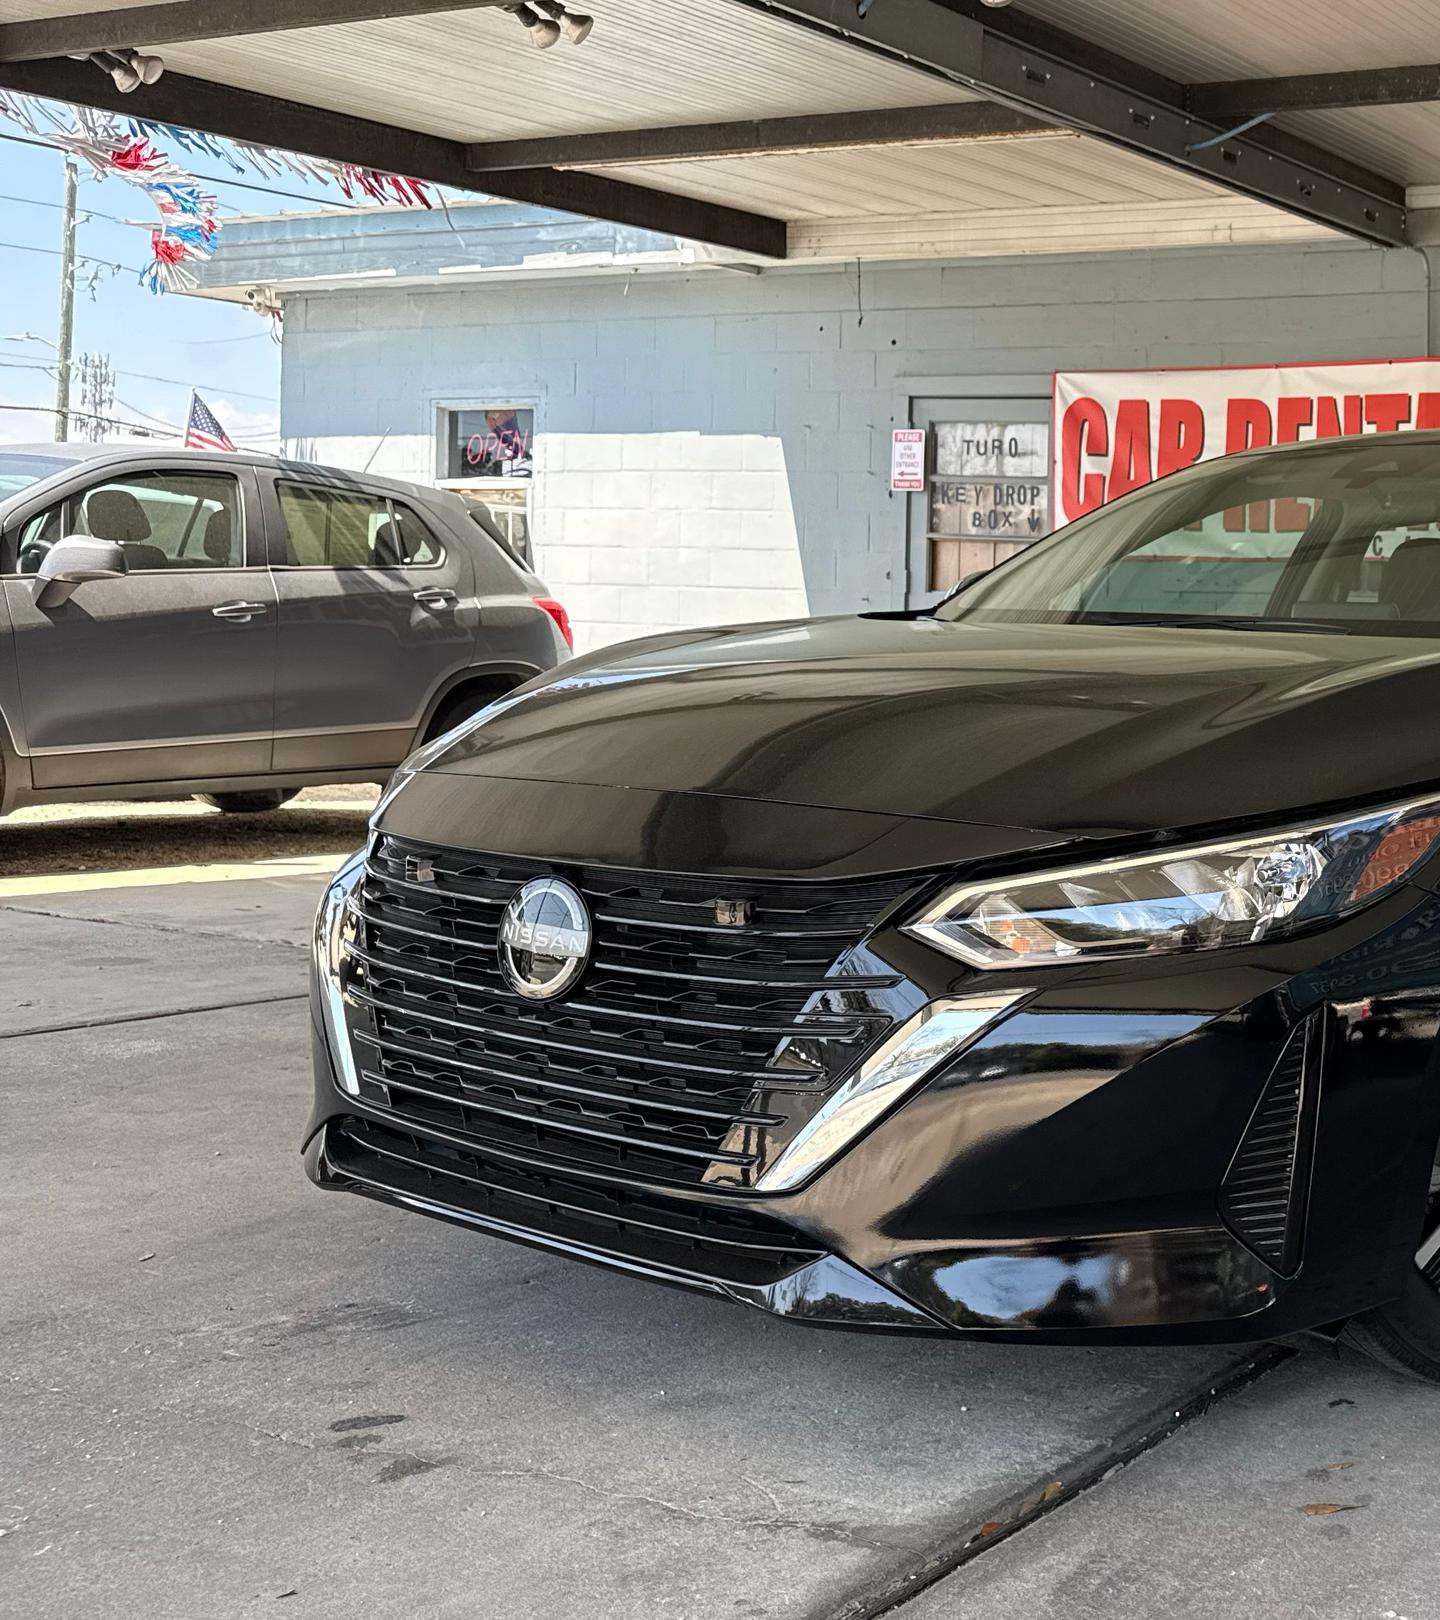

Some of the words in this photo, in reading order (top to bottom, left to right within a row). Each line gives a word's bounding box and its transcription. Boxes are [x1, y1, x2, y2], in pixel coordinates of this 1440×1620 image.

[896, 432, 921, 441] PLEASE
[467, 430, 529, 465] OPEN
[963, 437, 1019, 458] TURO
[1061, 397, 1206, 523] CAR
[941, 485, 983, 506] KEY
[994, 485, 1041, 506] DROP
[972, 510, 1014, 530] BOX
[503, 923, 585, 952] NISSAN
